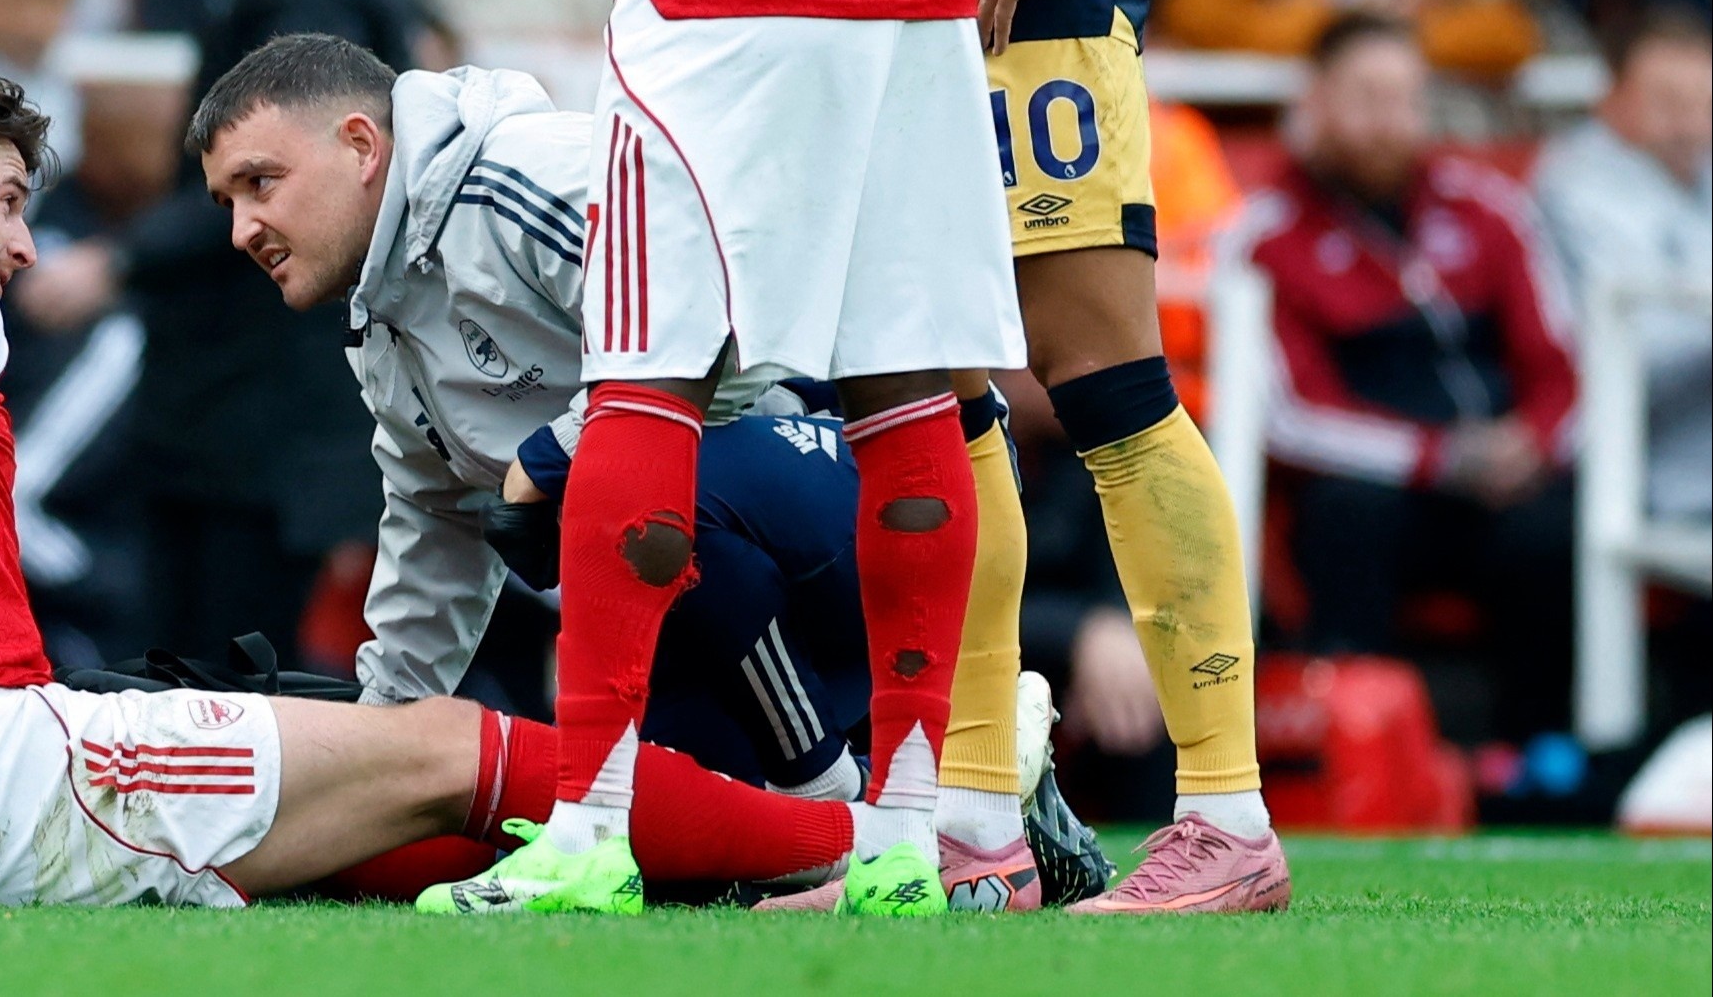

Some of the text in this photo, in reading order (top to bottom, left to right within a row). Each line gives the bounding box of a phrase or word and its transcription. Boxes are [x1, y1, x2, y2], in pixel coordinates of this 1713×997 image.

[988, 79, 1100, 188] 10
[1024, 216, 1070, 229] umbro
[1192, 674, 1239, 689] umbro
